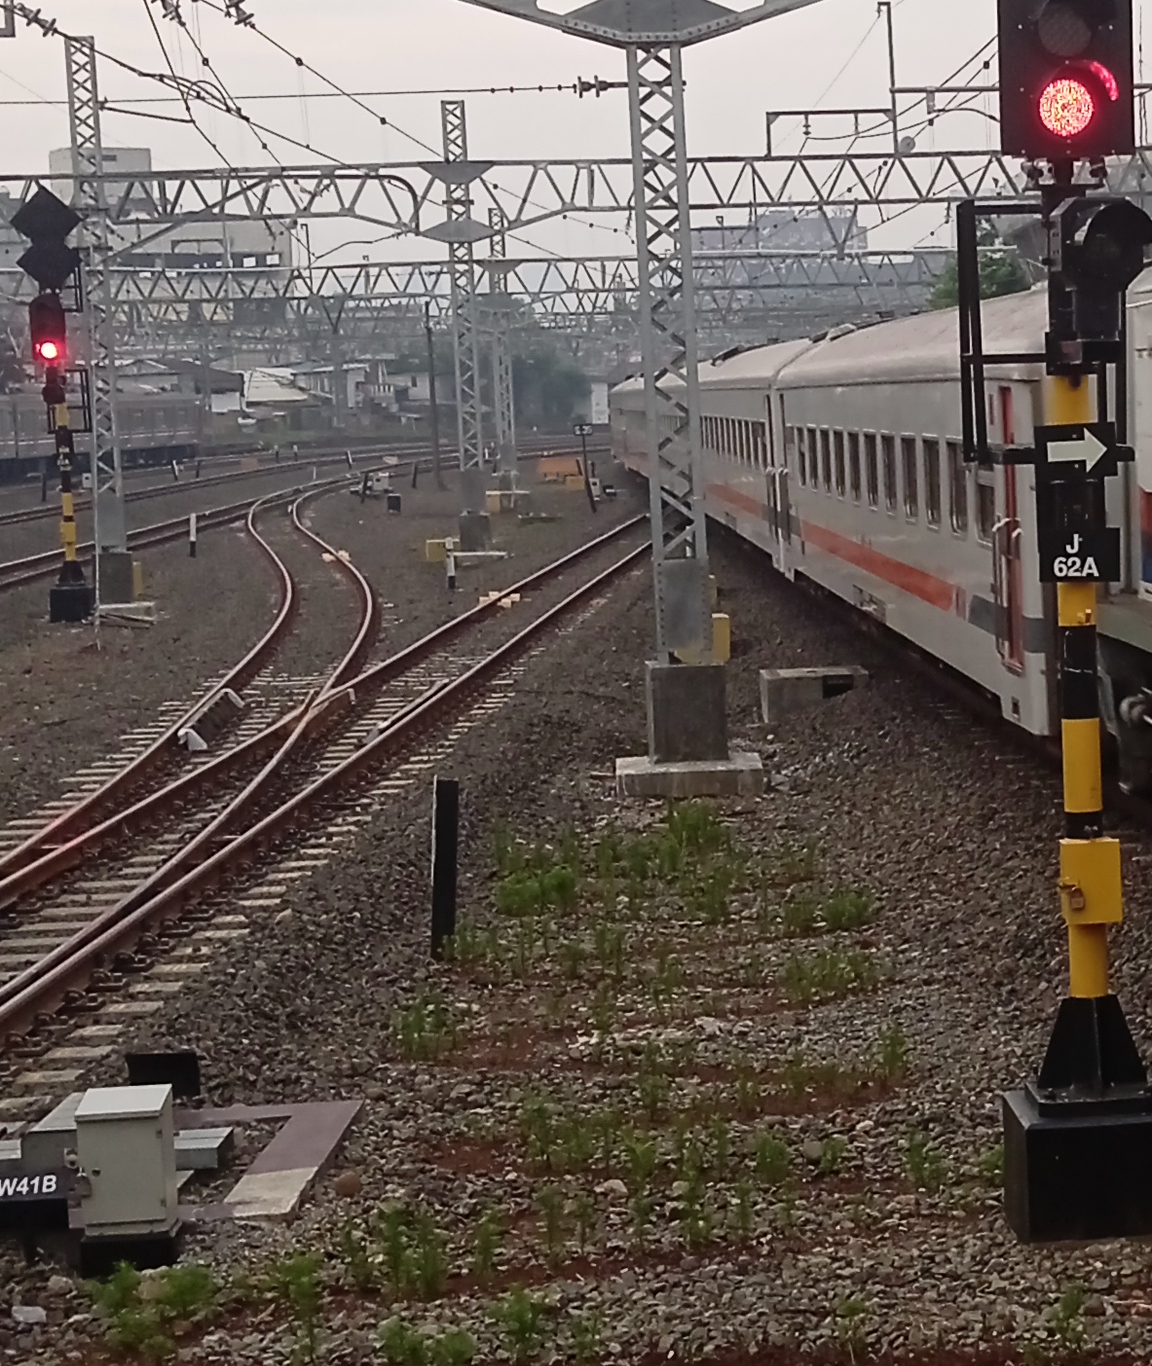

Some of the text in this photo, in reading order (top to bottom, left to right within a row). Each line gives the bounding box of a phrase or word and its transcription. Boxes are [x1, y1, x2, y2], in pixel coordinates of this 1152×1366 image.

[1065, 534, 1079, 554] J
[1053, 556, 1100, 577] 62A
[0, 1175, 57, 1195] W41B
